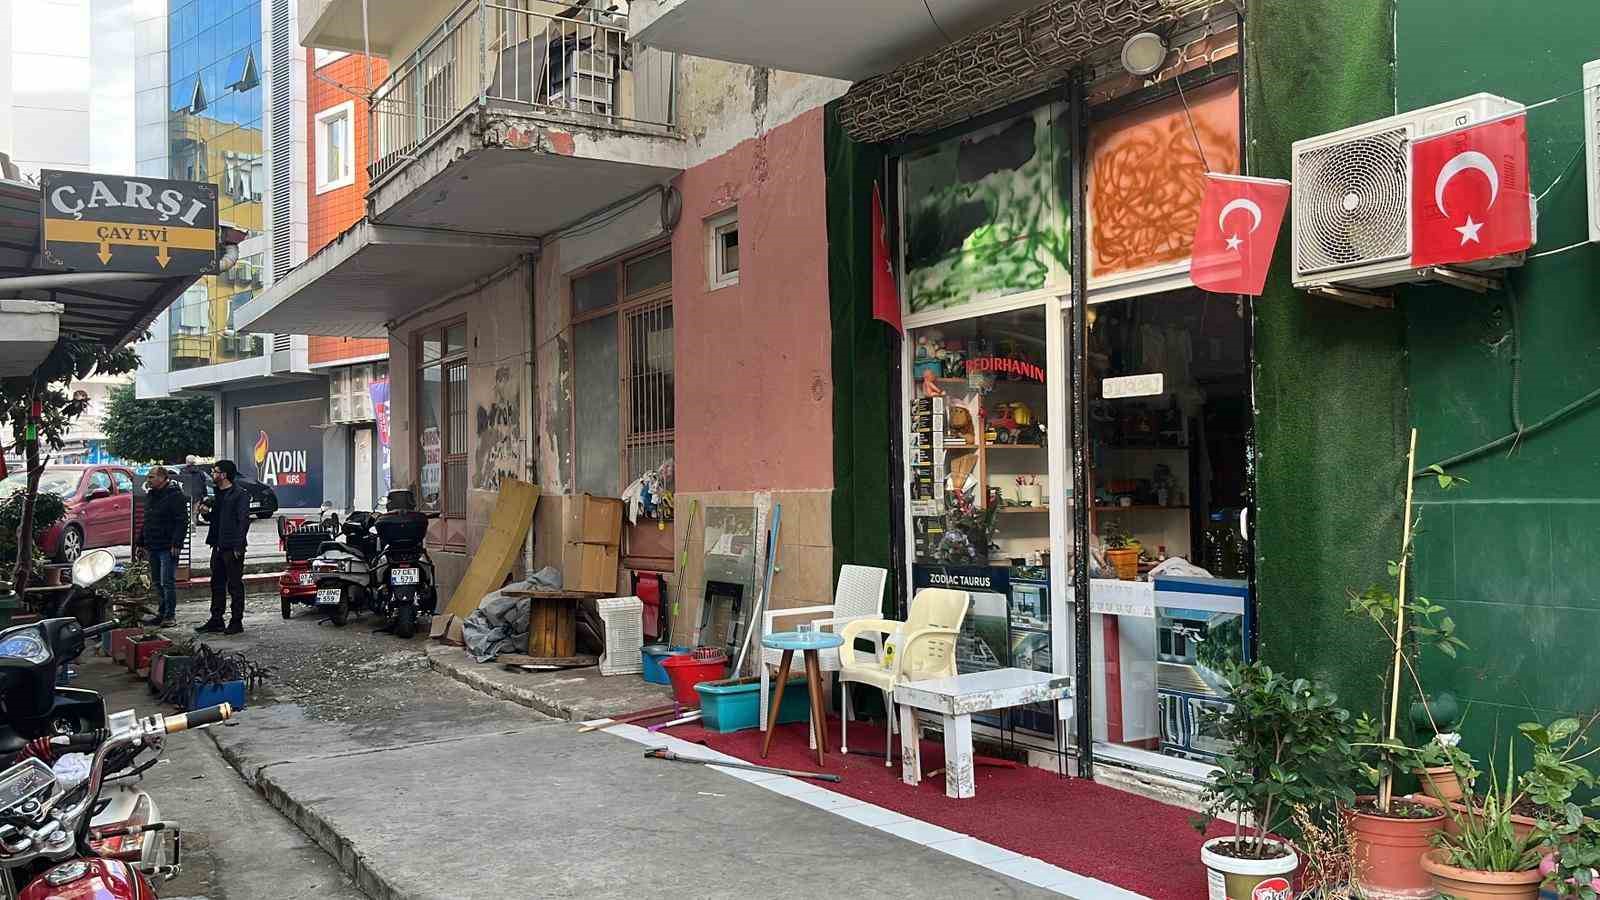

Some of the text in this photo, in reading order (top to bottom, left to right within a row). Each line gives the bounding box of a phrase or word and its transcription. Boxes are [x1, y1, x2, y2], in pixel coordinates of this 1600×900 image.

[51, 180, 208, 226] ÇARŞI
[96, 226, 169, 243] ÇAY EVİ
[263, 449, 307, 486] AYDIN
[929, 573, 992, 587] ZODIAC TAURUS
